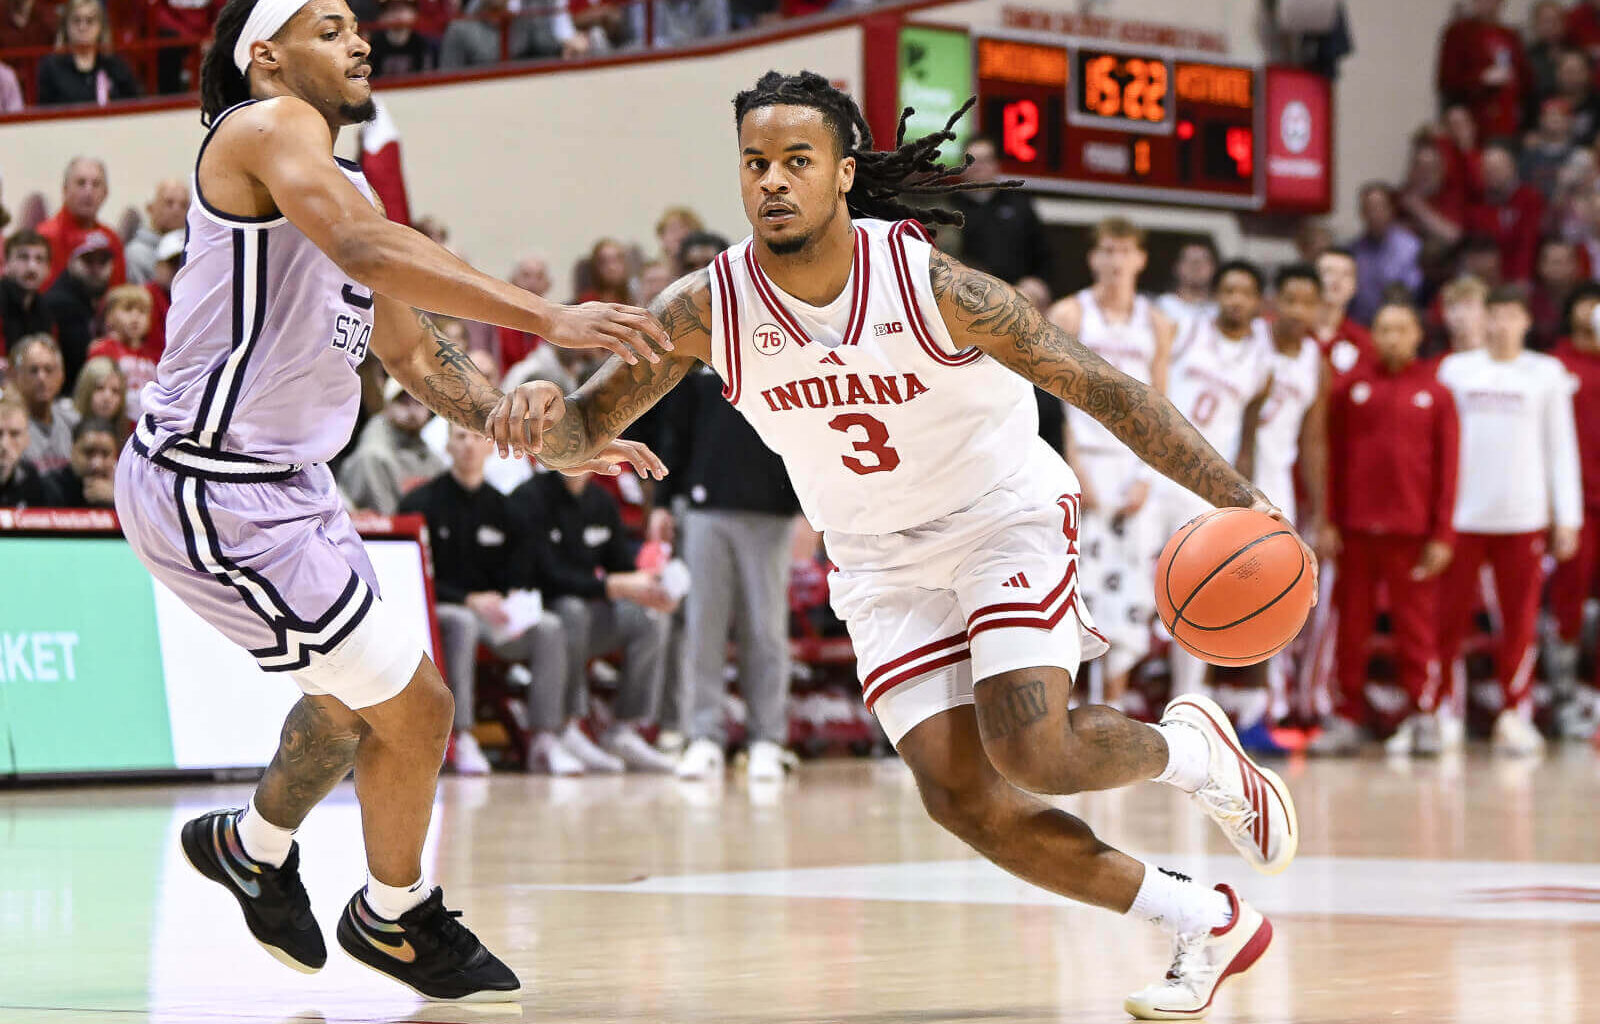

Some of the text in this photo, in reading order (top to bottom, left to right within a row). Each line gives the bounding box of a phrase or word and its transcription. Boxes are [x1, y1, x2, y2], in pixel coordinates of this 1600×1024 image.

[761, 373, 930, 412] INDIANA
[828, 413, 900, 475] 3
[0, 631, 79, 681] KET
